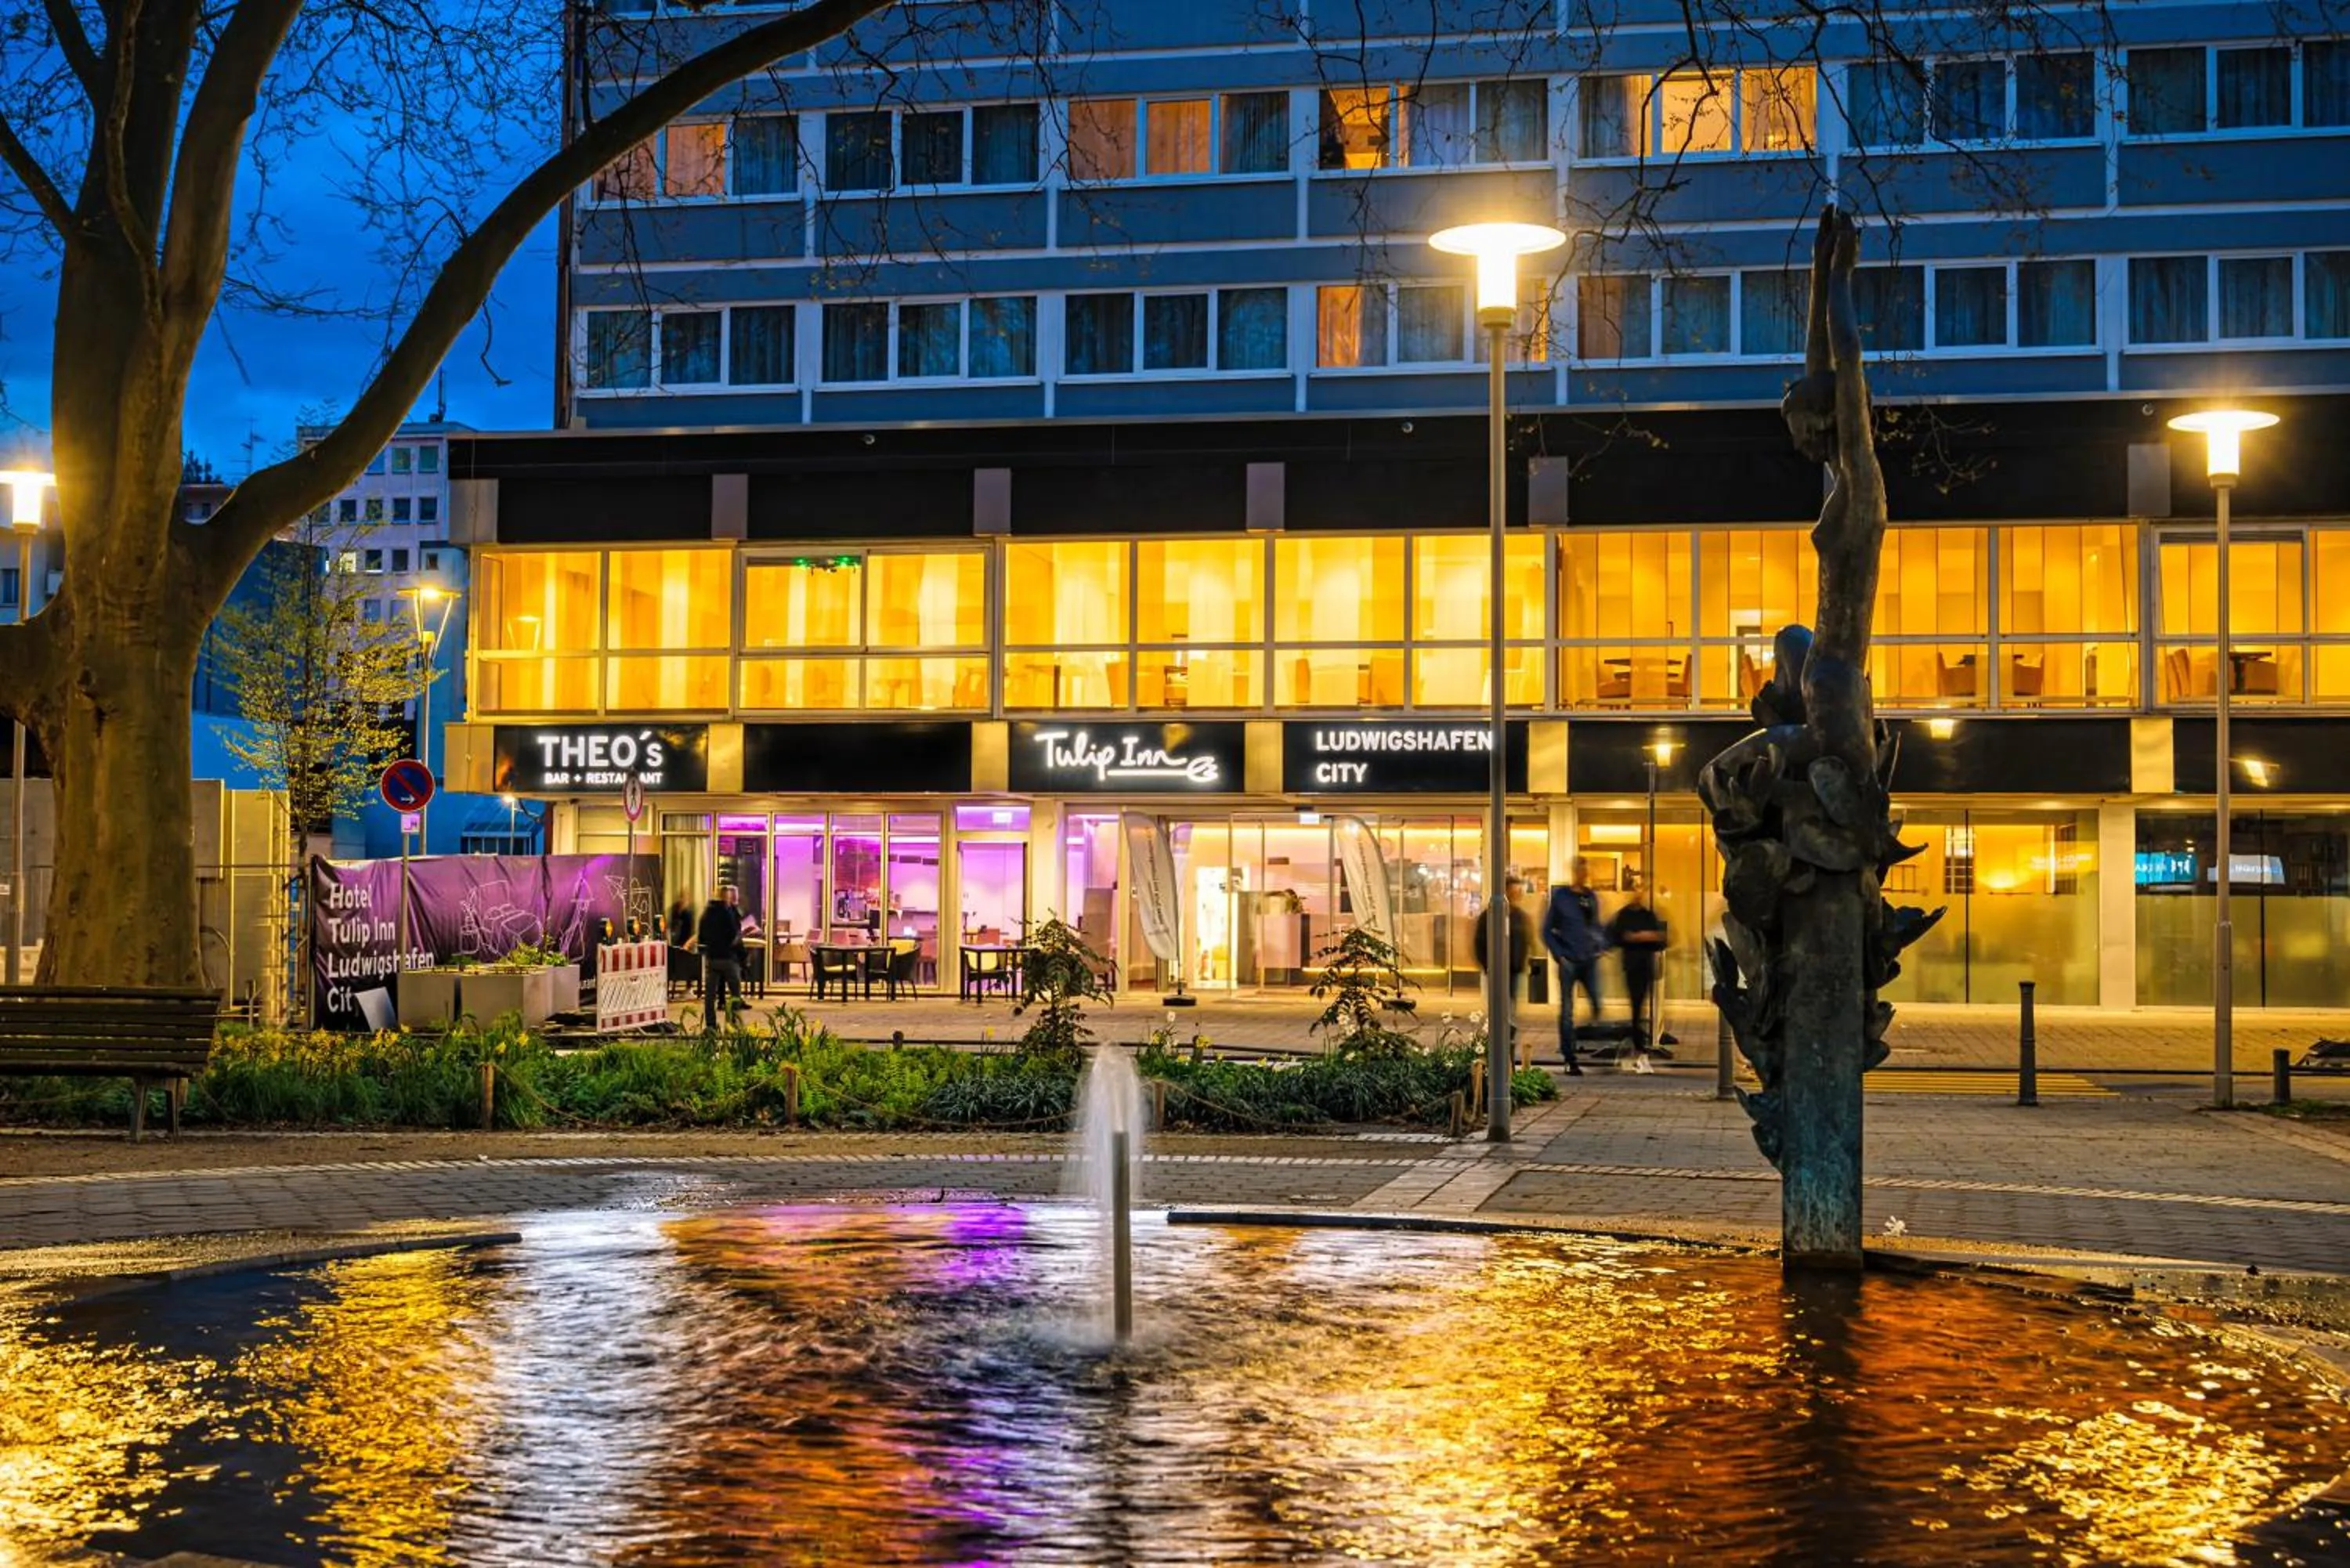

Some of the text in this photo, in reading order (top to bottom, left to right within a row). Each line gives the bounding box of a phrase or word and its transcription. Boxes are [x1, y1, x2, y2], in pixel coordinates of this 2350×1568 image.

[1316, 731, 1492, 751] LUDWIGSHAFEN
[1034, 732, 1187, 781] Tulip Inn
[544, 772, 569, 783] BAR
[586, 772, 663, 783] RESTAANT
[1316, 763, 1368, 782] CITY
[330, 883, 373, 909] Hotel
[328, 916, 395, 948] Tulip Inn
